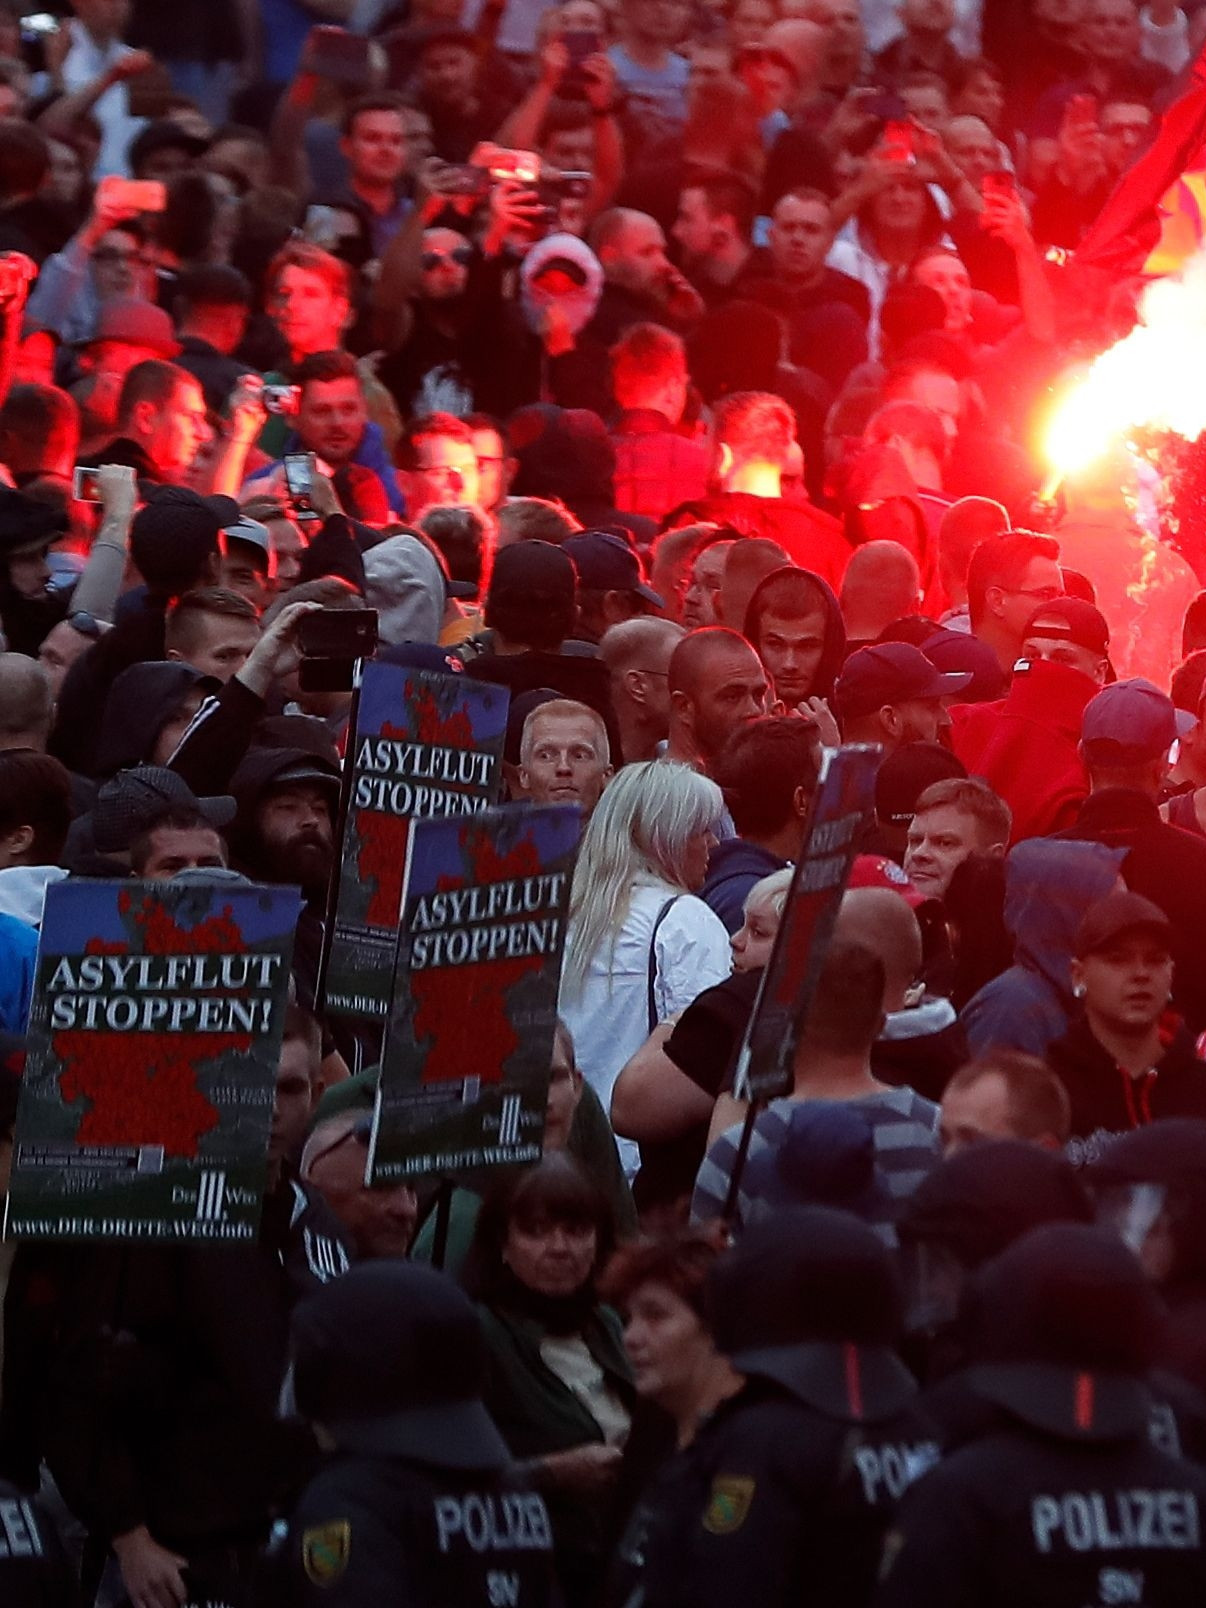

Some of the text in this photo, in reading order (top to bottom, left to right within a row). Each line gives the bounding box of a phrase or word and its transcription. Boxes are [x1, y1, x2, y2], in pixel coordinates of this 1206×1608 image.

[355, 737, 495, 787] ASYLFLUT
[411, 871, 566, 933] ASYLFLUT
[411, 918, 560, 970] STOPPEN!
[47, 954, 282, 993] ASYLFLUT
[51, 996, 272, 1033] STOPPEN!
[1032, 1488, 1200, 1553] POLIZEI
